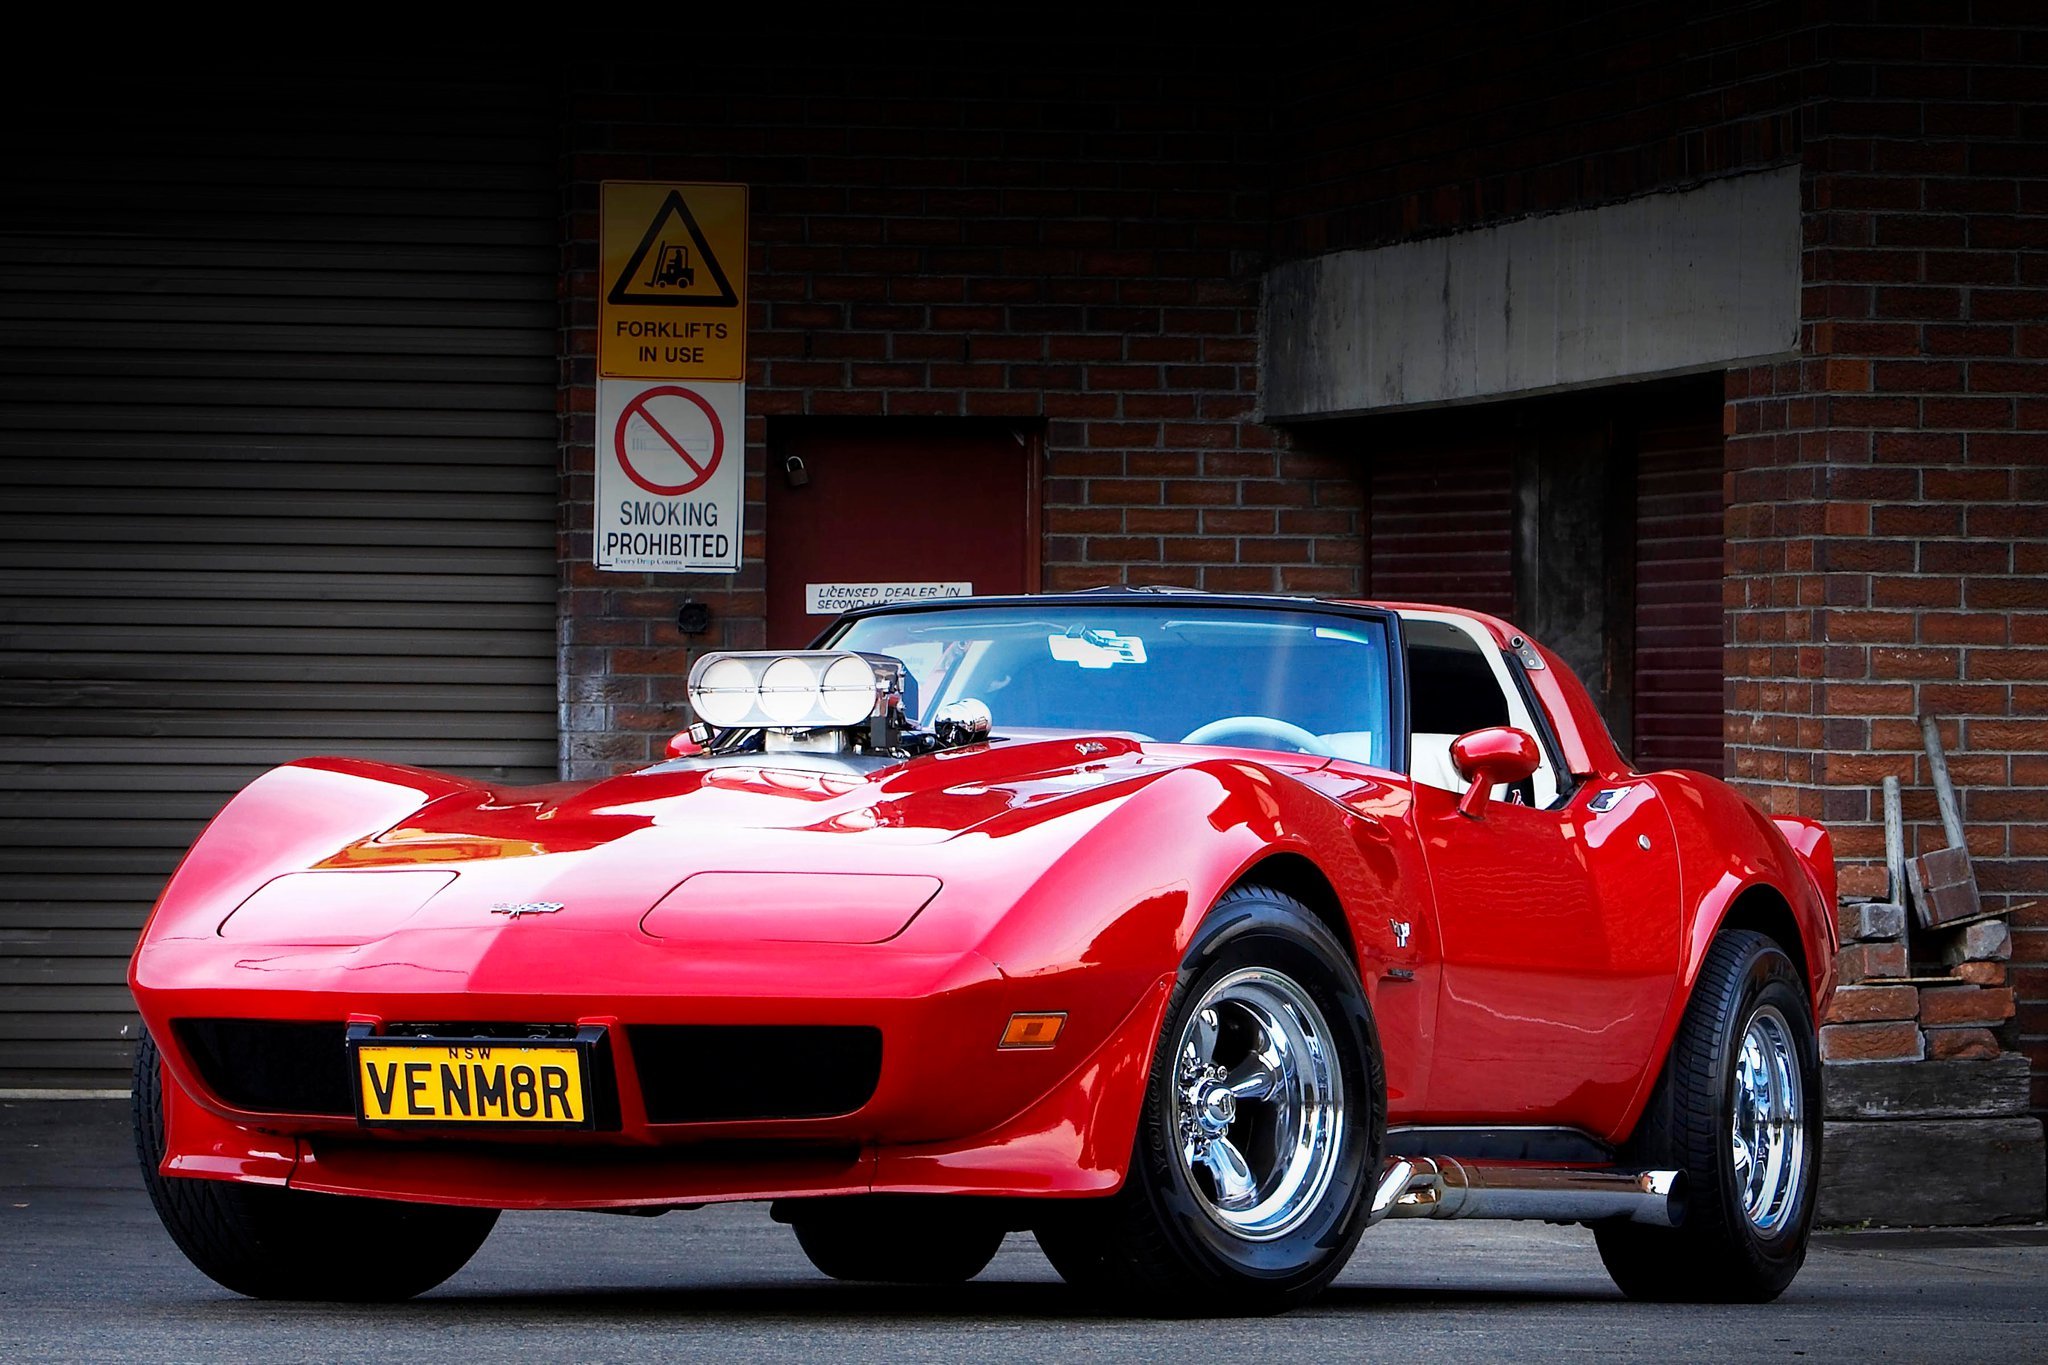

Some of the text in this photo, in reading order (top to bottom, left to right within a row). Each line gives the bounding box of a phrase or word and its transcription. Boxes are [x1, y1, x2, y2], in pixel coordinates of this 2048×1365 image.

[617, 322, 728, 338] FORKLIFTS
[639, 346, 704, 363] IN USE
[620, 501, 717, 526] SMOKING
[607, 532, 728, 557] PROHIBITED
[819, 587, 960, 598] LICENSED DEALER IN
[448, 1047, 491, 1059] NSW
[367, 1063, 573, 1118] VENM8R
